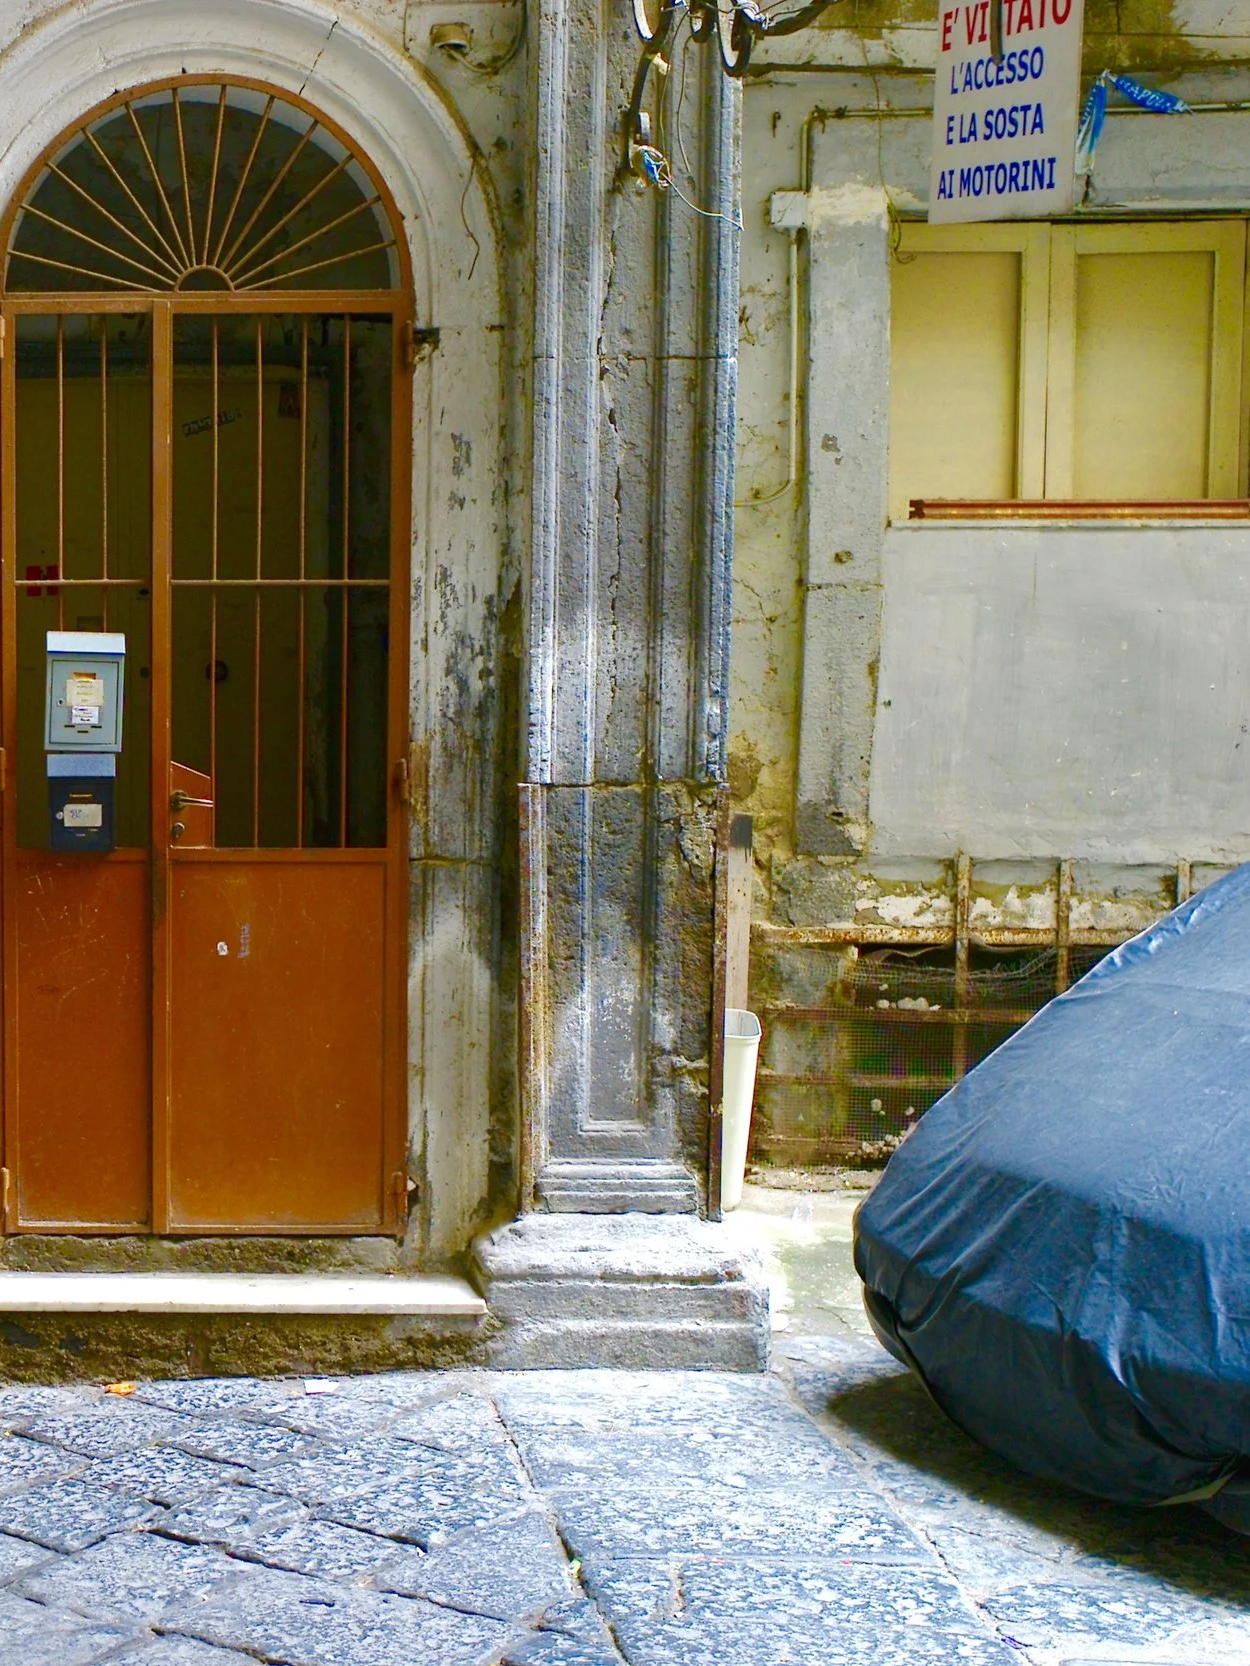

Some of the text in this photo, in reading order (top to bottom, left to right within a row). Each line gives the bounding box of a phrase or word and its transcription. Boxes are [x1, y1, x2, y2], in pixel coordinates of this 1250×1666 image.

[942, 0, 1071, 51] E' VITATO
[951, 46, 1044, 95] L'ACCESSO
[946, 103, 1044, 145] E LA SOSTA
[938, 157, 1056, 200] AI MOTORINI
